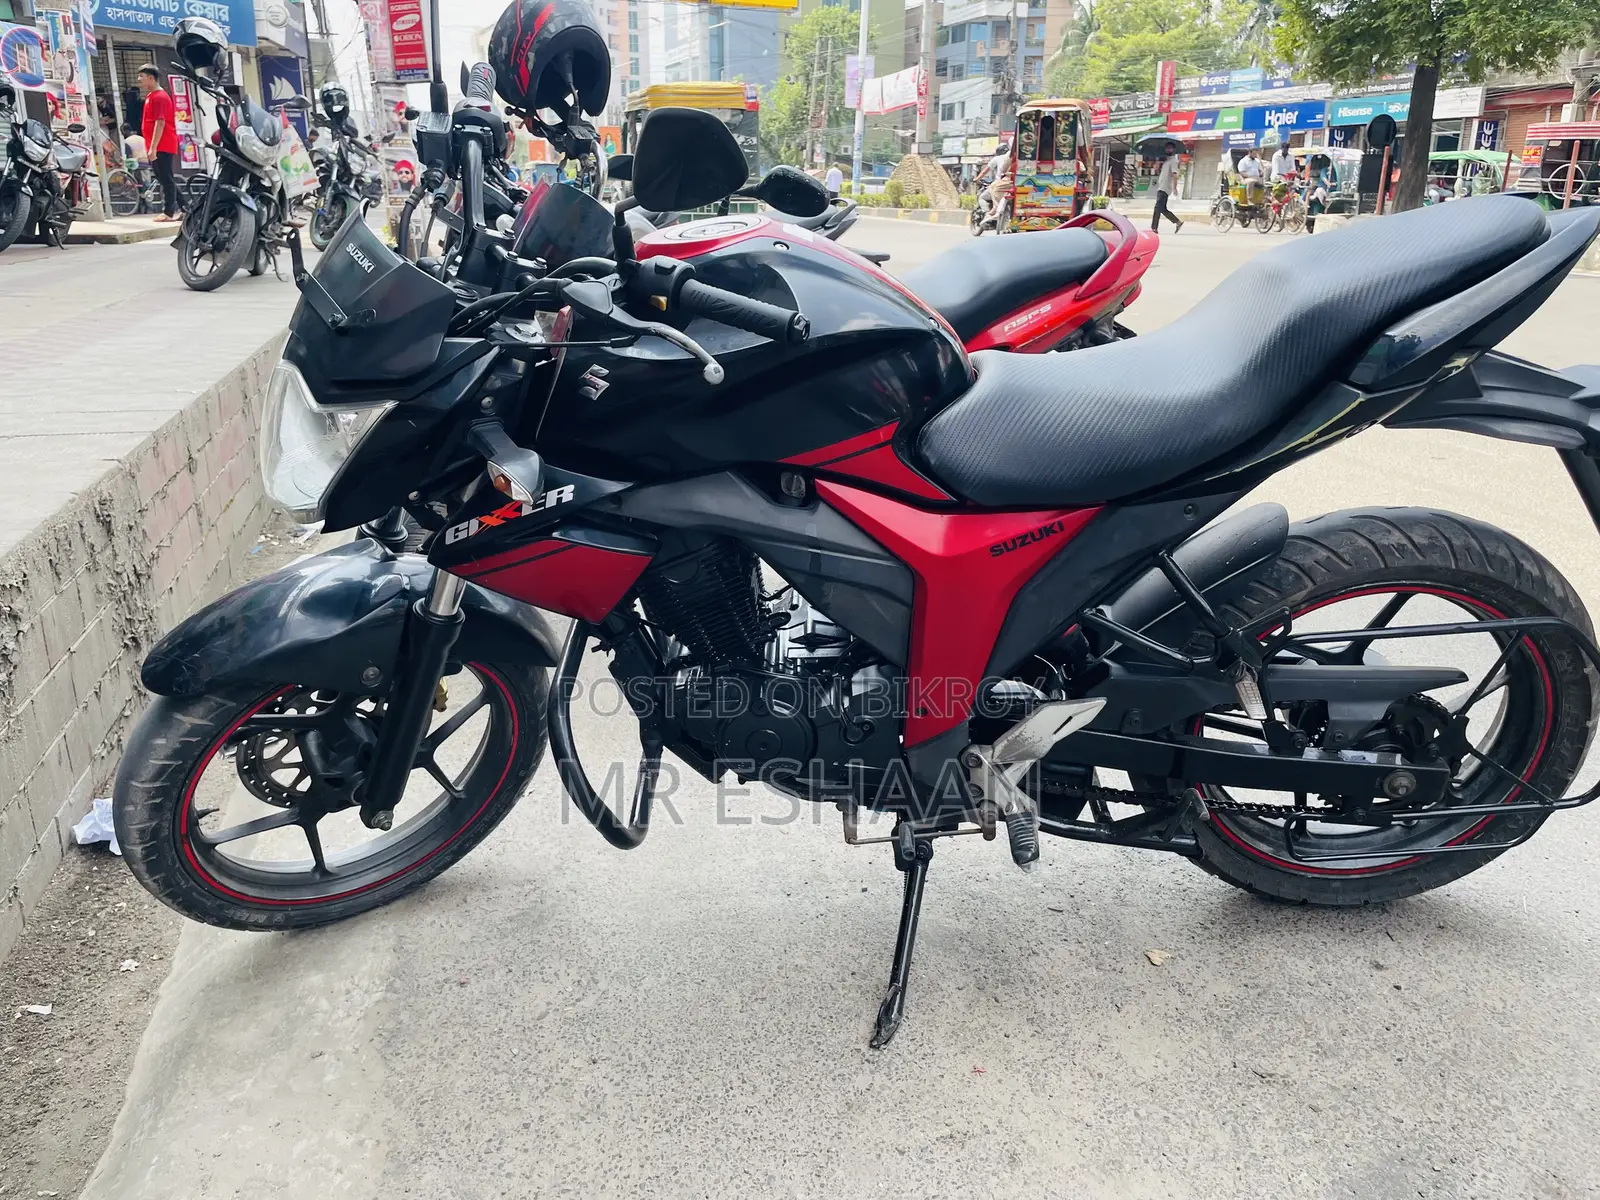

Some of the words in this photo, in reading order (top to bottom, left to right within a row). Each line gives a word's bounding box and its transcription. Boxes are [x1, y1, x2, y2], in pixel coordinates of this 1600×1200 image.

[105, 7, 154, 25] হাসপাতাল
[1209, 75, 1230, 86] GREE
[1265, 108, 1299, 127] Haier
[1338, 106, 1373, 118] Hisense
[346, 242, 375, 274] SUZUKI
[989, 520, 1064, 557] SUZUKI
